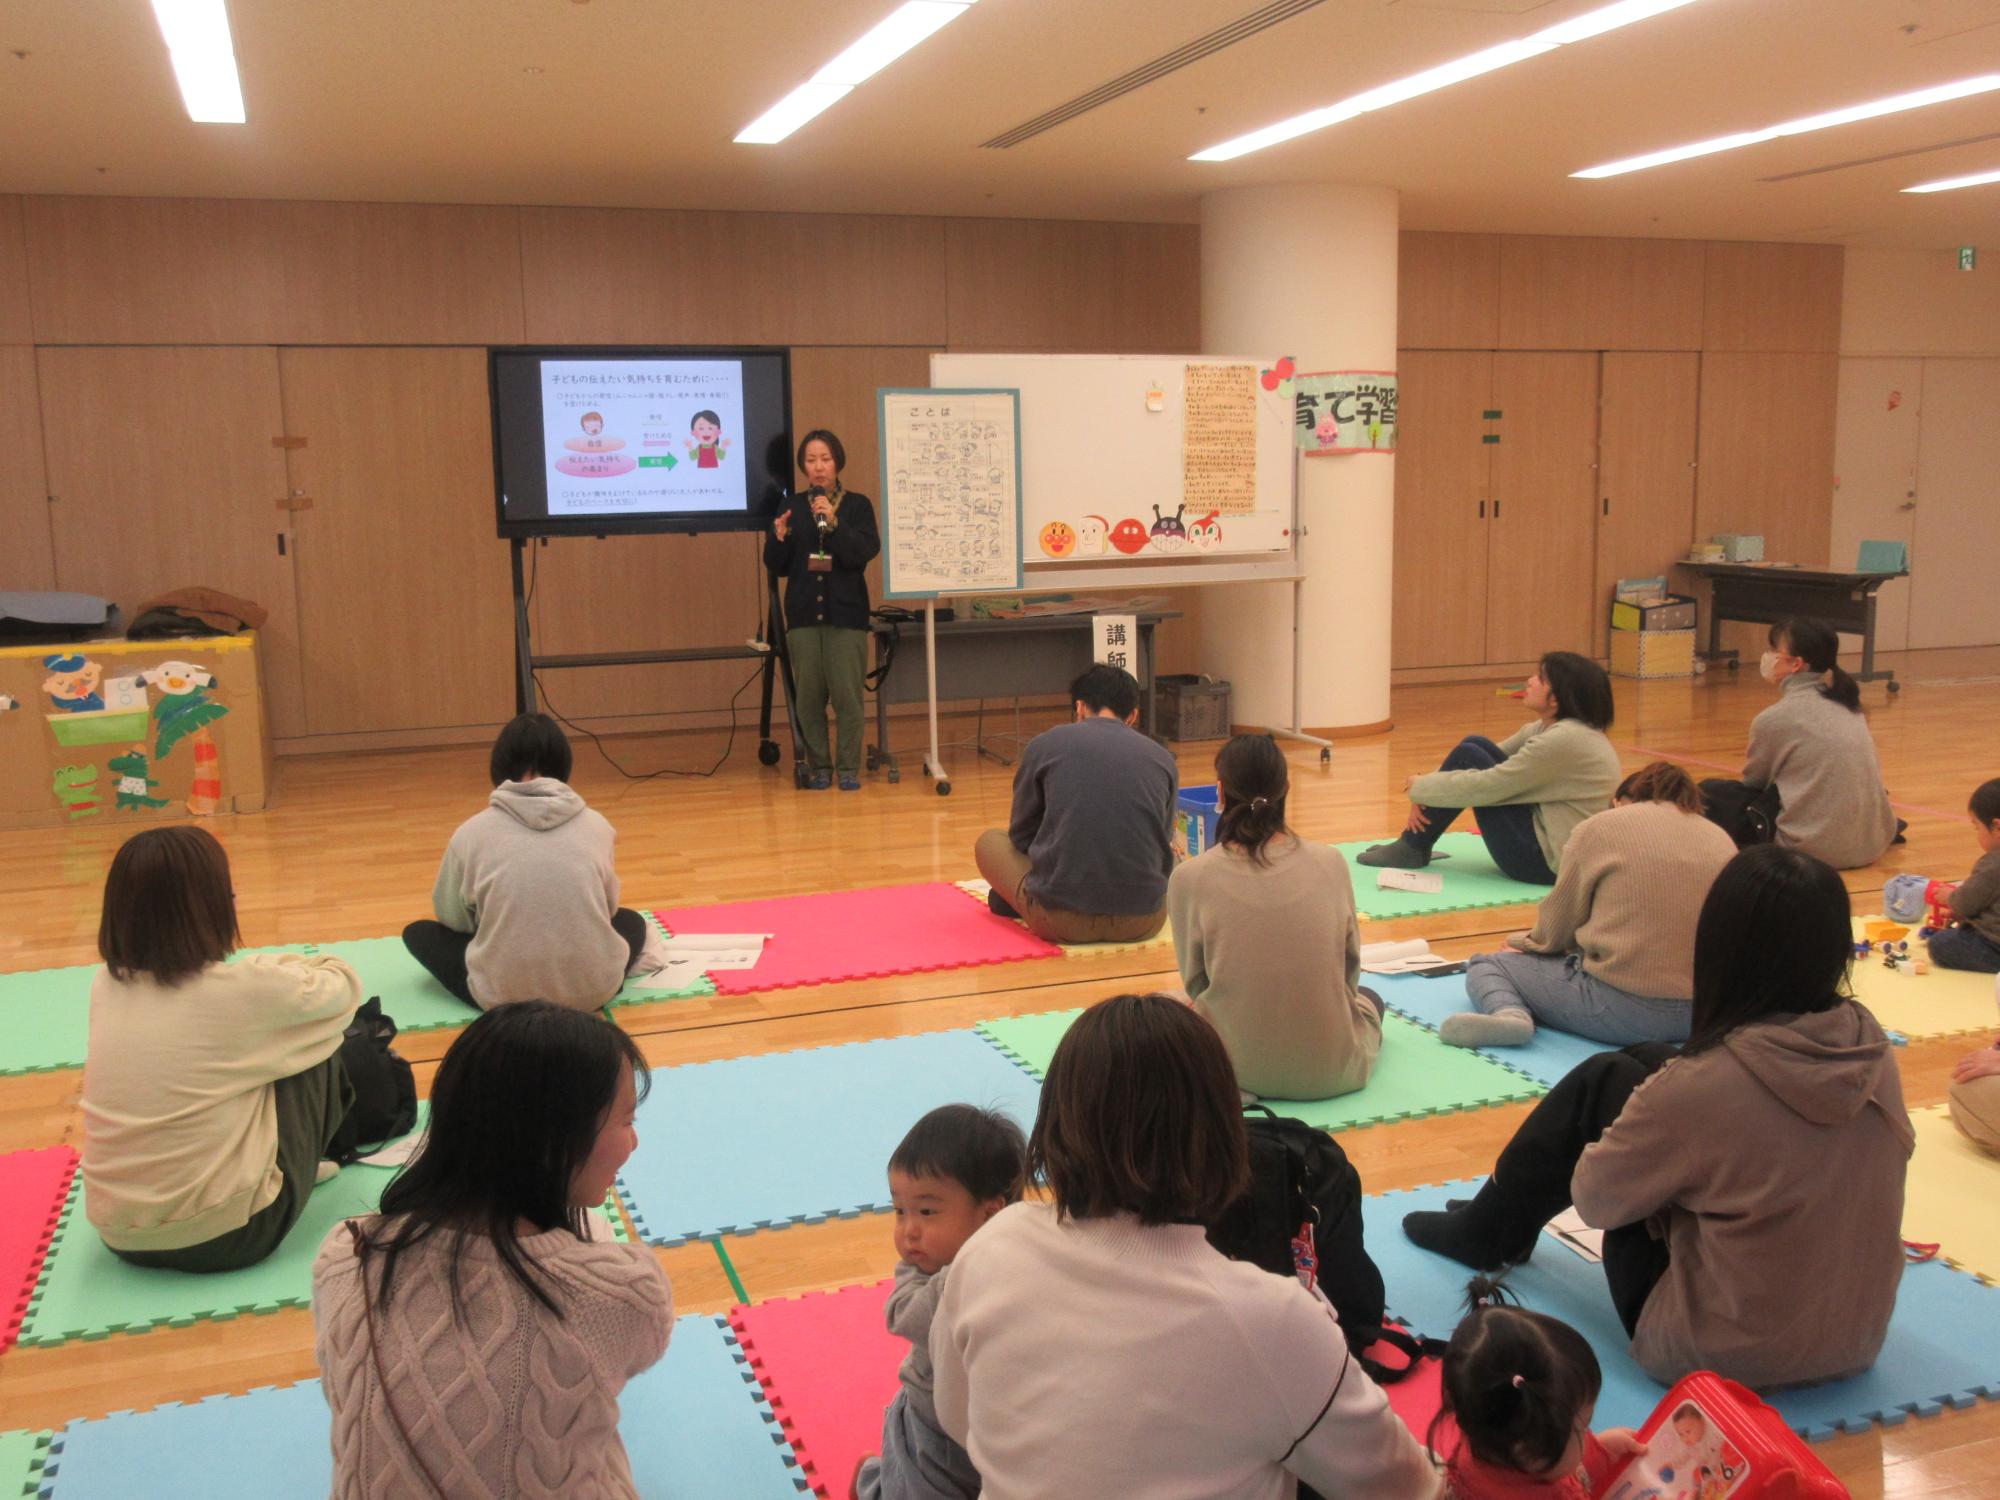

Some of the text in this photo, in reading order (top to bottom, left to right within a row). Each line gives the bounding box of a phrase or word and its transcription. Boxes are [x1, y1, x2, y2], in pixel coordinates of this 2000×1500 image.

[909, 407, 952, 417] ことば
[568, 455, 621, 464] 伝えたい気持ち
[1105, 623, 1127, 669] 講師
